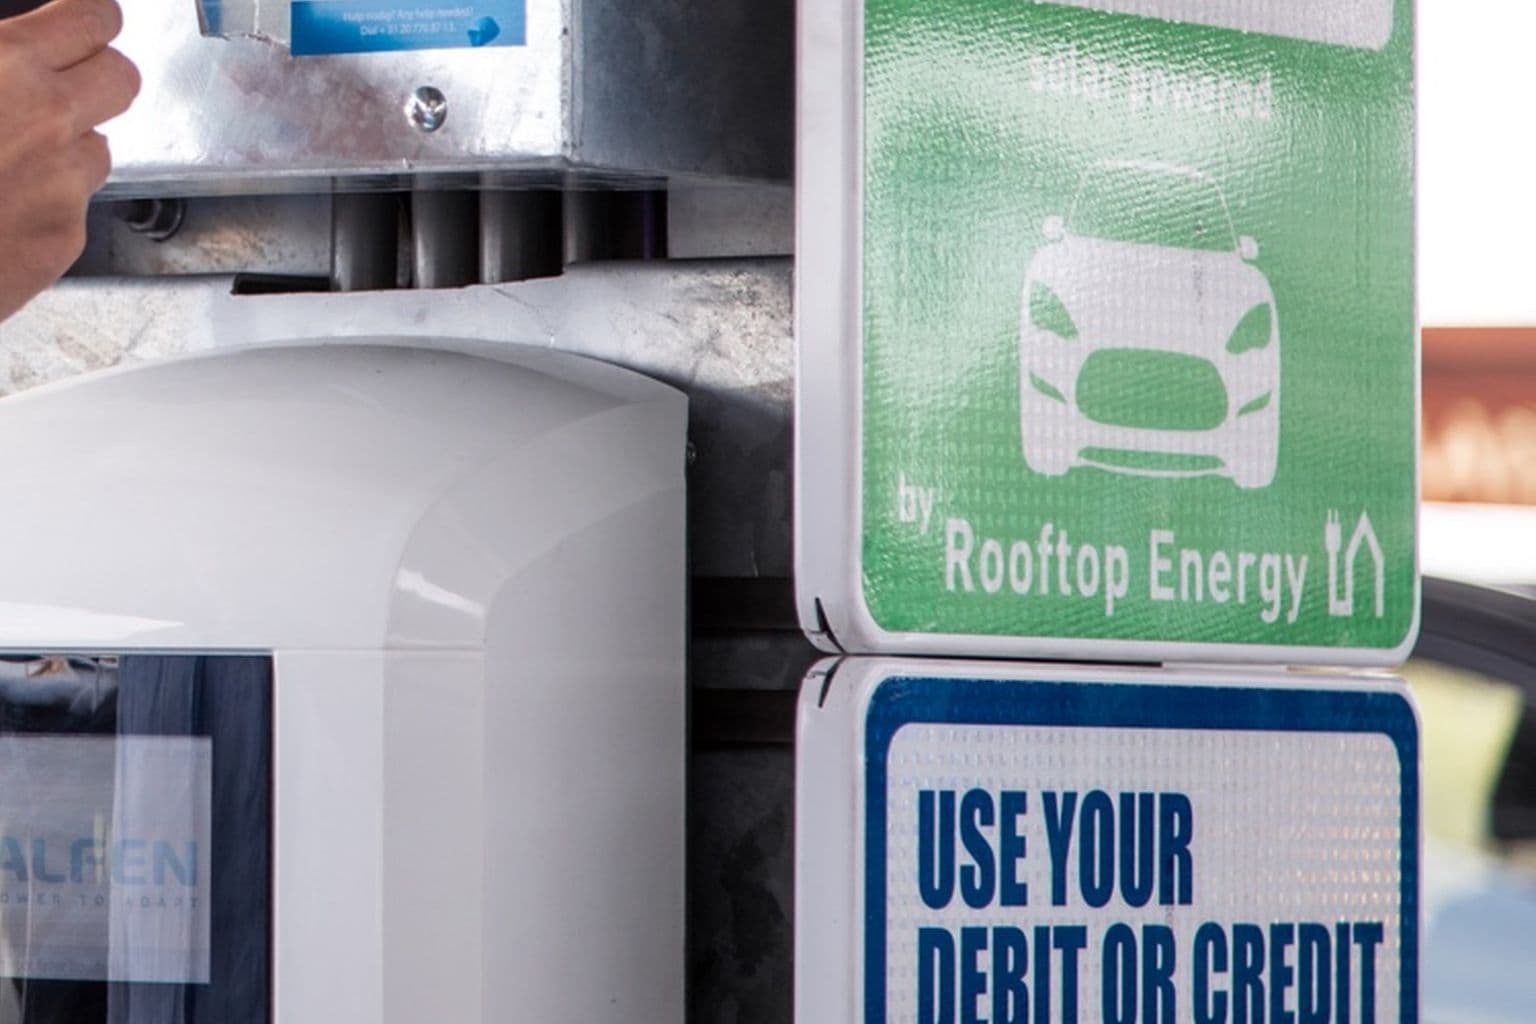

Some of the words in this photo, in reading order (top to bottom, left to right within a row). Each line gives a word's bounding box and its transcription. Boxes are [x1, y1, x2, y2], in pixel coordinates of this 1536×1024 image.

[898, 472, 934, 535] by
[945, 517, 1129, 617] Rooftop
[1150, 528, 1308, 624] Energy
[918, 788, 1027, 909] USE
[1041, 789, 1193, 908] YOUR
[918, 925, 1088, 1024] DEBIT
[1101, 922, 1177, 1024] OR
[1193, 921, 1384, 1024] CREDIT
